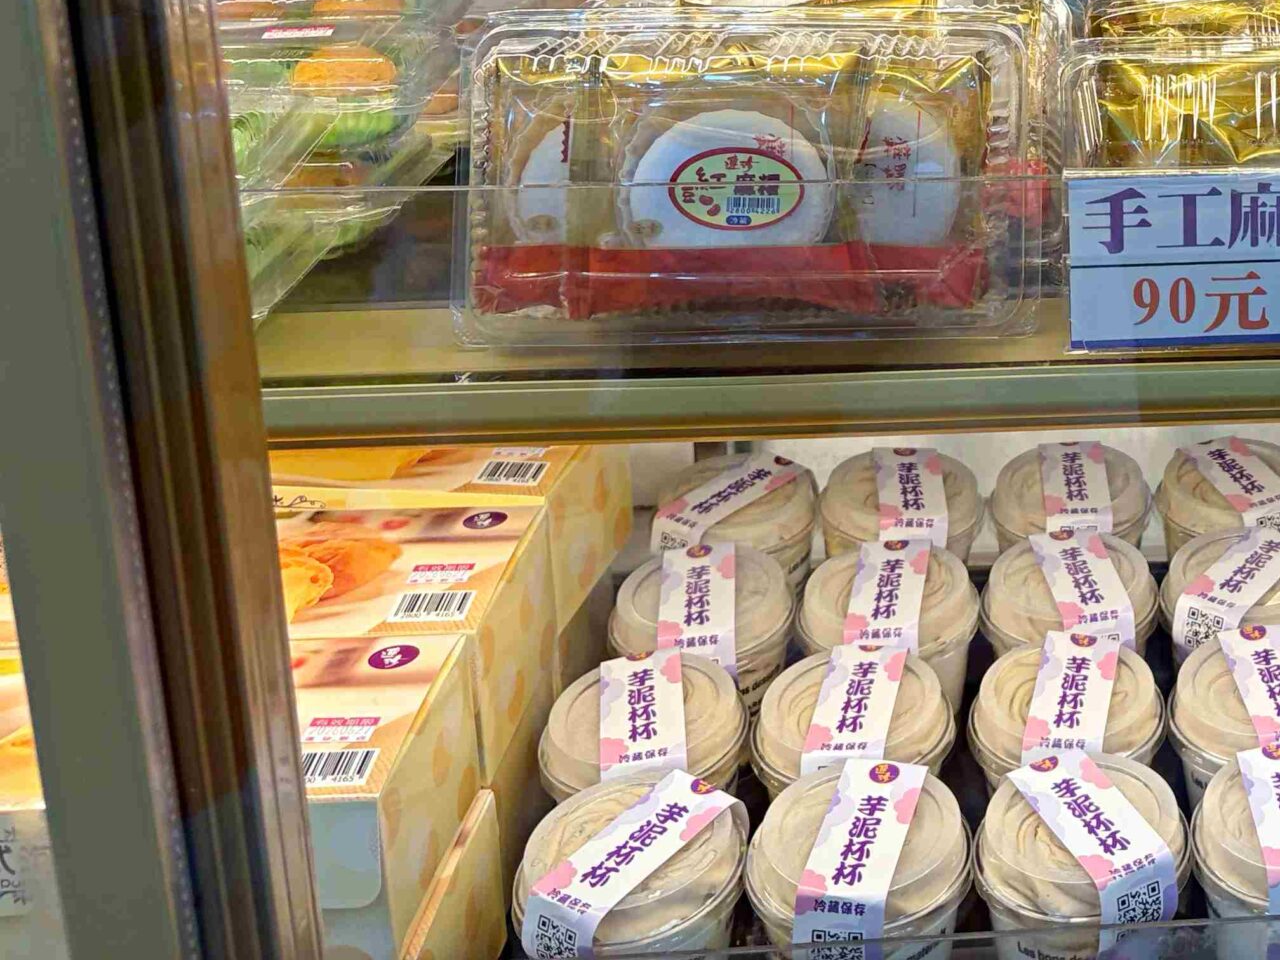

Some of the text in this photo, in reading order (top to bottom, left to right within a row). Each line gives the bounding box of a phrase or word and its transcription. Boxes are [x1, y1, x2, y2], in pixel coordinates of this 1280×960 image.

[1132, 270, 1270, 333] 90元
[1061, 451, 1089, 502] 芋泥杯杯
[683, 565, 711, 627] 芋泥杯杯
[871, 558, 905, 621] 芋泥杯杯
[1059, 547, 1104, 606] 芋泥杯杯
[627, 668, 658, 742] 芋泥杯杯
[835, 661, 880, 734] 芋泥杯杯
[1053, 656, 1092, 729] 芋泥杯杯
[579, 801, 690, 889] 芋泥杯杯
[831, 794, 888, 886] 芋泥杯杯
[1050, 776, 1131, 856] 芋泥杯杯
[812, 898, 867, 917] 冷藏保存
